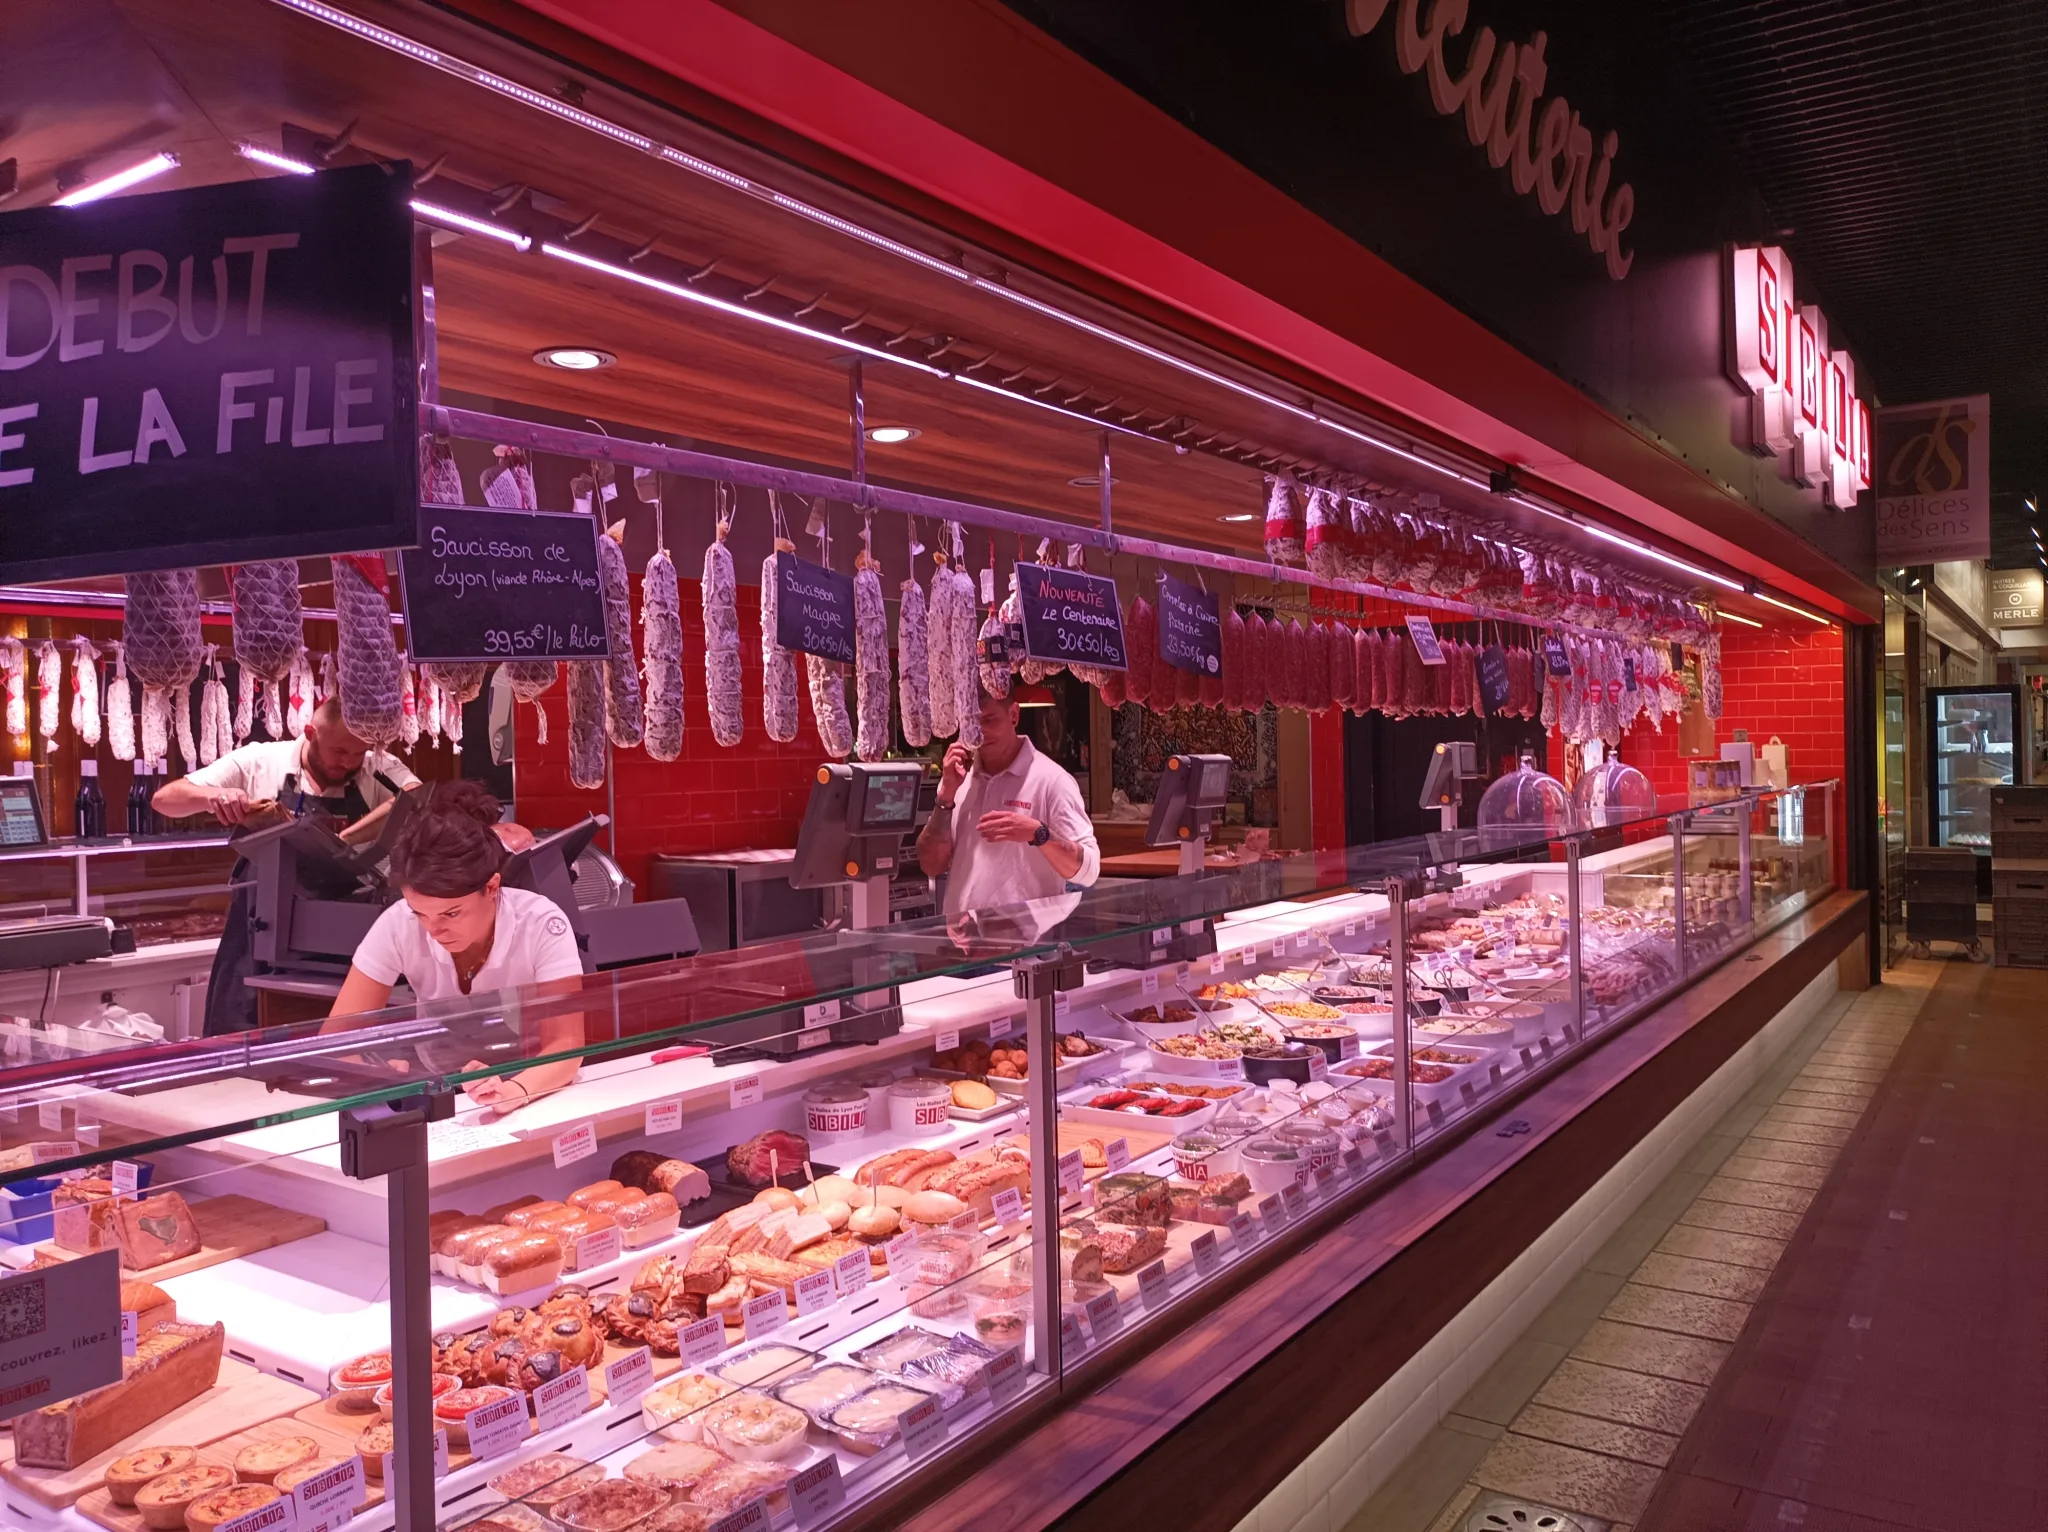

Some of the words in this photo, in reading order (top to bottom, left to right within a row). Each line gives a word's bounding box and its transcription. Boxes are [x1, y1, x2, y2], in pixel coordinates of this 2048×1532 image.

[0, 233, 300, 370] DEBUT
[1757, 249, 1872, 487] SIBILIA
[79, 387, 187, 475] LA
[1877, 497, 1970, 521] Délices
[1877, 523, 1908, 537] des
[1910, 518, 1970, 539] Sens
[431, 526, 534, 560] Saucisson
[544, 543, 570, 562] de
[434, 563, 487, 598] Lyon
[491, 568, 528, 592] (viande
[786, 570, 837, 603] Saucisson
[802, 603, 845, 629] Maigre
[1042, 607, 1058, 621] Le
[1062, 606, 1118, 631] Centenaire
[1993, 609, 2039, 619] MERLE
[72, 1332, 107, 1350] likez
[474, 1399, 520, 1428] SIBILIA
[303, 1464, 355, 1500] SIBILIA
[309, 1497, 328, 1511] QUICHE
[329, 1484, 353, 1501] LORRAINE
